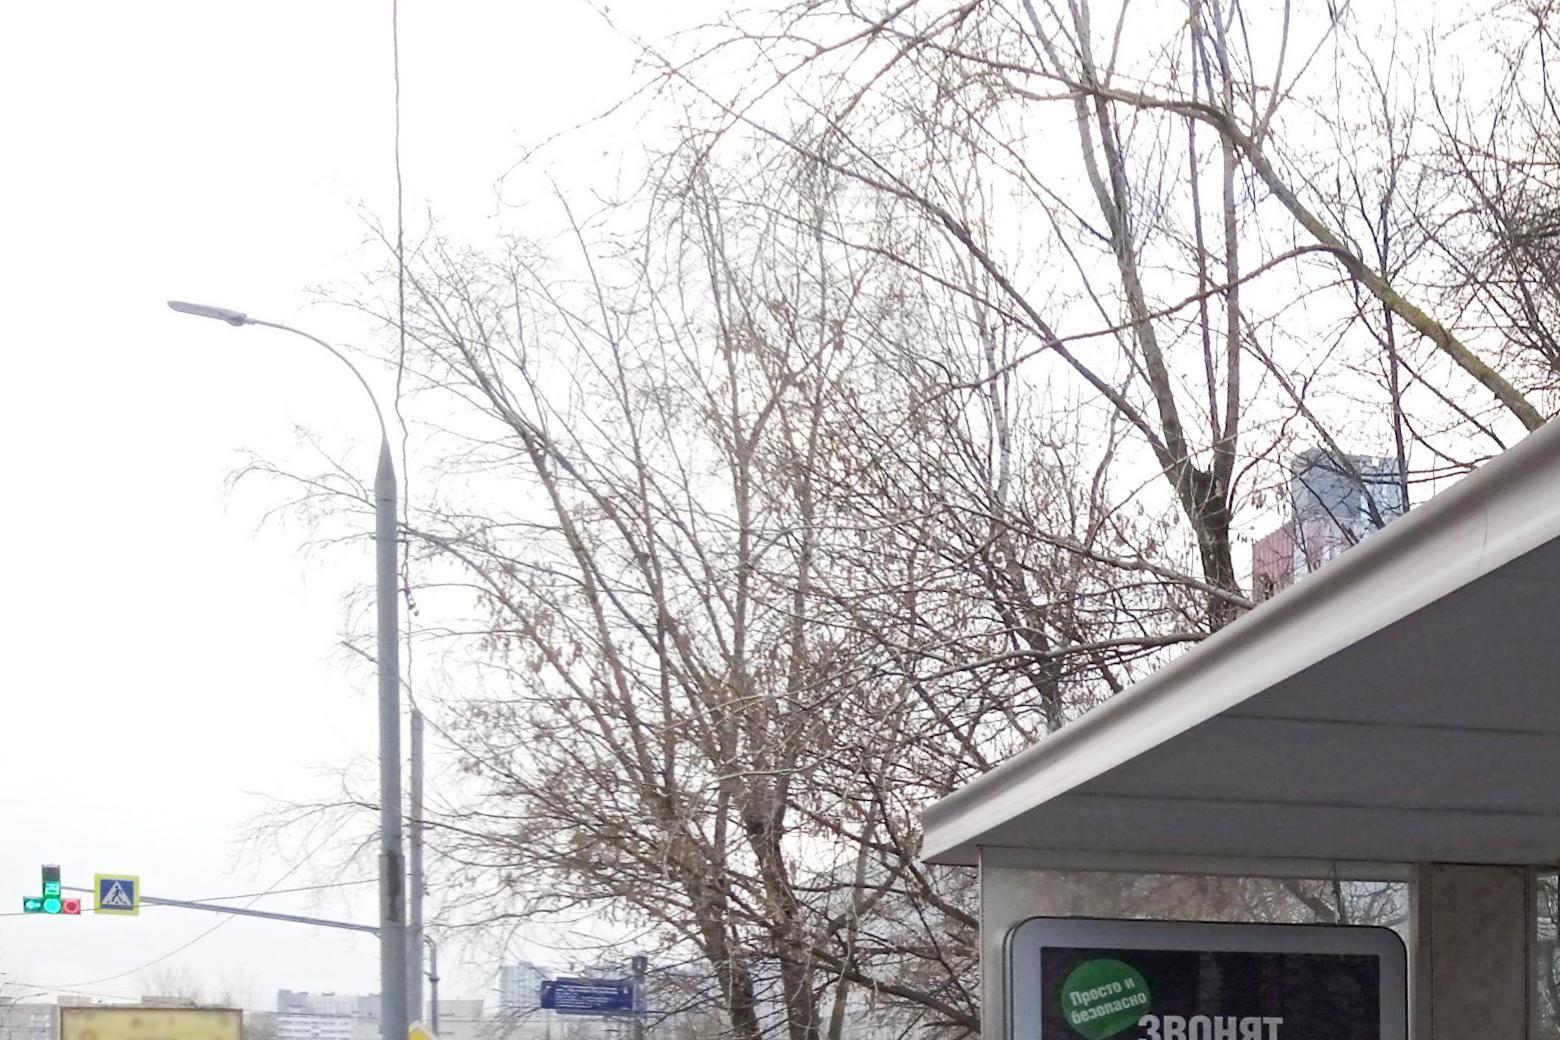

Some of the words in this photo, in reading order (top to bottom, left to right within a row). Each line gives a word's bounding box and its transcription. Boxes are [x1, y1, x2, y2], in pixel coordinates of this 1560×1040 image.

[1070, 981, 1122, 1006] Просто
[1124, 978, 1135, 989] и
[1071, 992, 1147, 1024] безопасно
